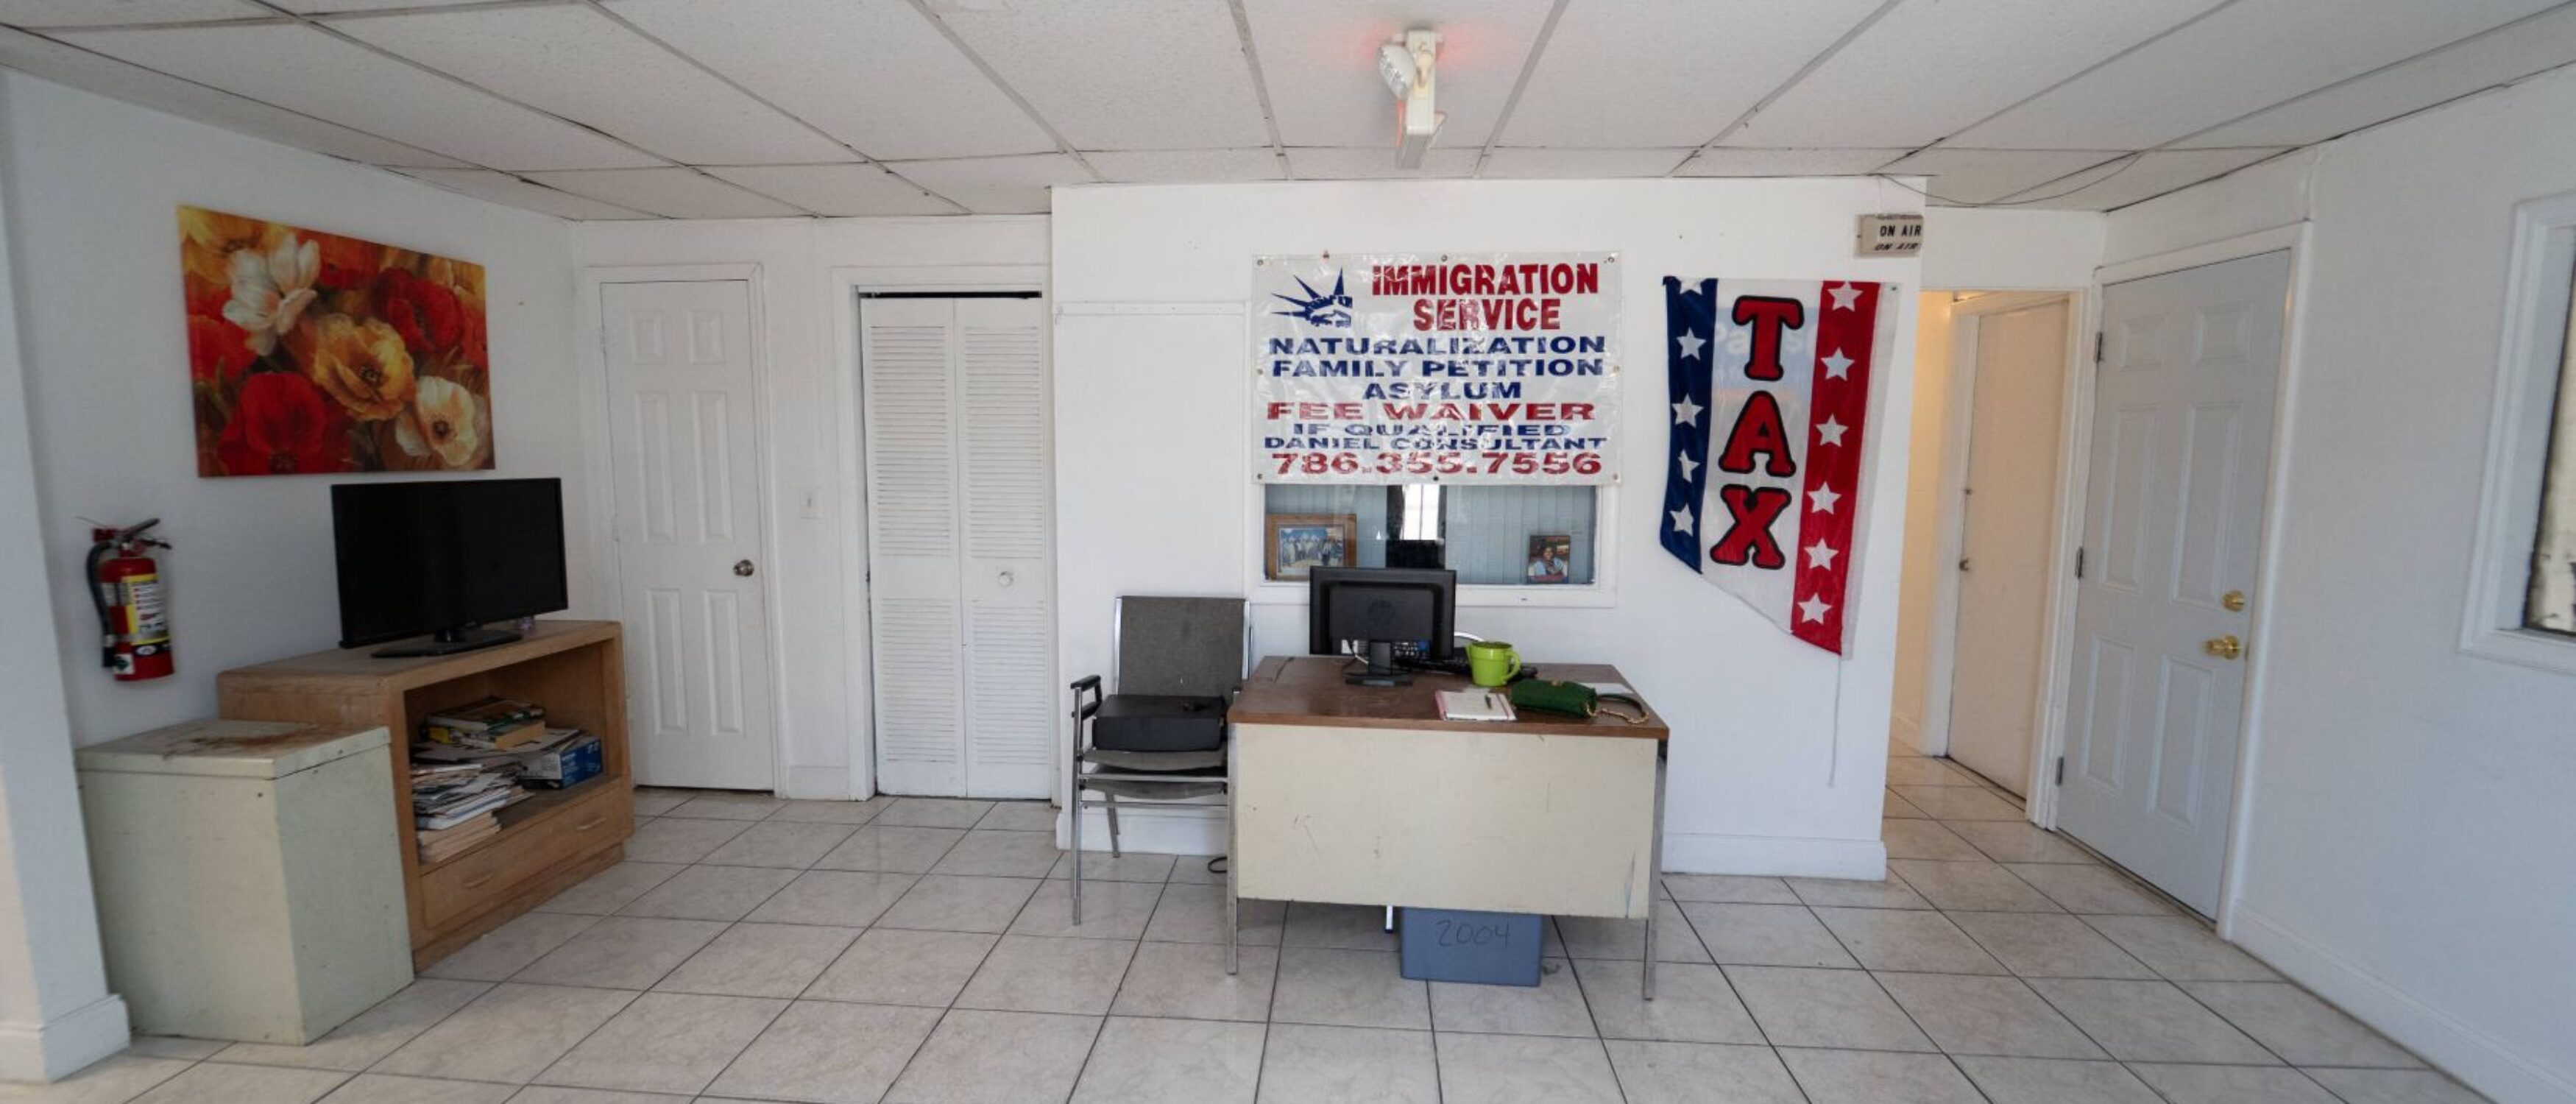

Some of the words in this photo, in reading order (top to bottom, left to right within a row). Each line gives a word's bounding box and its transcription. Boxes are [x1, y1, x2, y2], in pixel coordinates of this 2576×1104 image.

[1880, 224, 1896, 237] ON
[1901, 224, 1922, 237] AIR
[1372, 263, 1599, 295] IMMIGRATION
[1412, 297, 1561, 331] SERVICE
[1269, 336, 1606, 354] NATURALIZATION
[1273, 359, 1409, 377] FAMILY
[1421, 358, 1604, 376] PETITION
[1362, 381, 1522, 400] ASYLUM
[1267, 402, 1364, 420] FEE
[1381, 402, 1596, 420] WAIVER
[1292, 423, 1328, 435] IF
[1344, 423, 1569, 436] QUALIFIED
[1710, 295, 1805, 570] TAX
[1264, 436, 1381, 450] DANIEL
[1390, 437, 1607, 450] CONSULTANT
[1271, 452, 1602, 475] 786.355.7556
[1436, 919, 1511, 951] 2004
